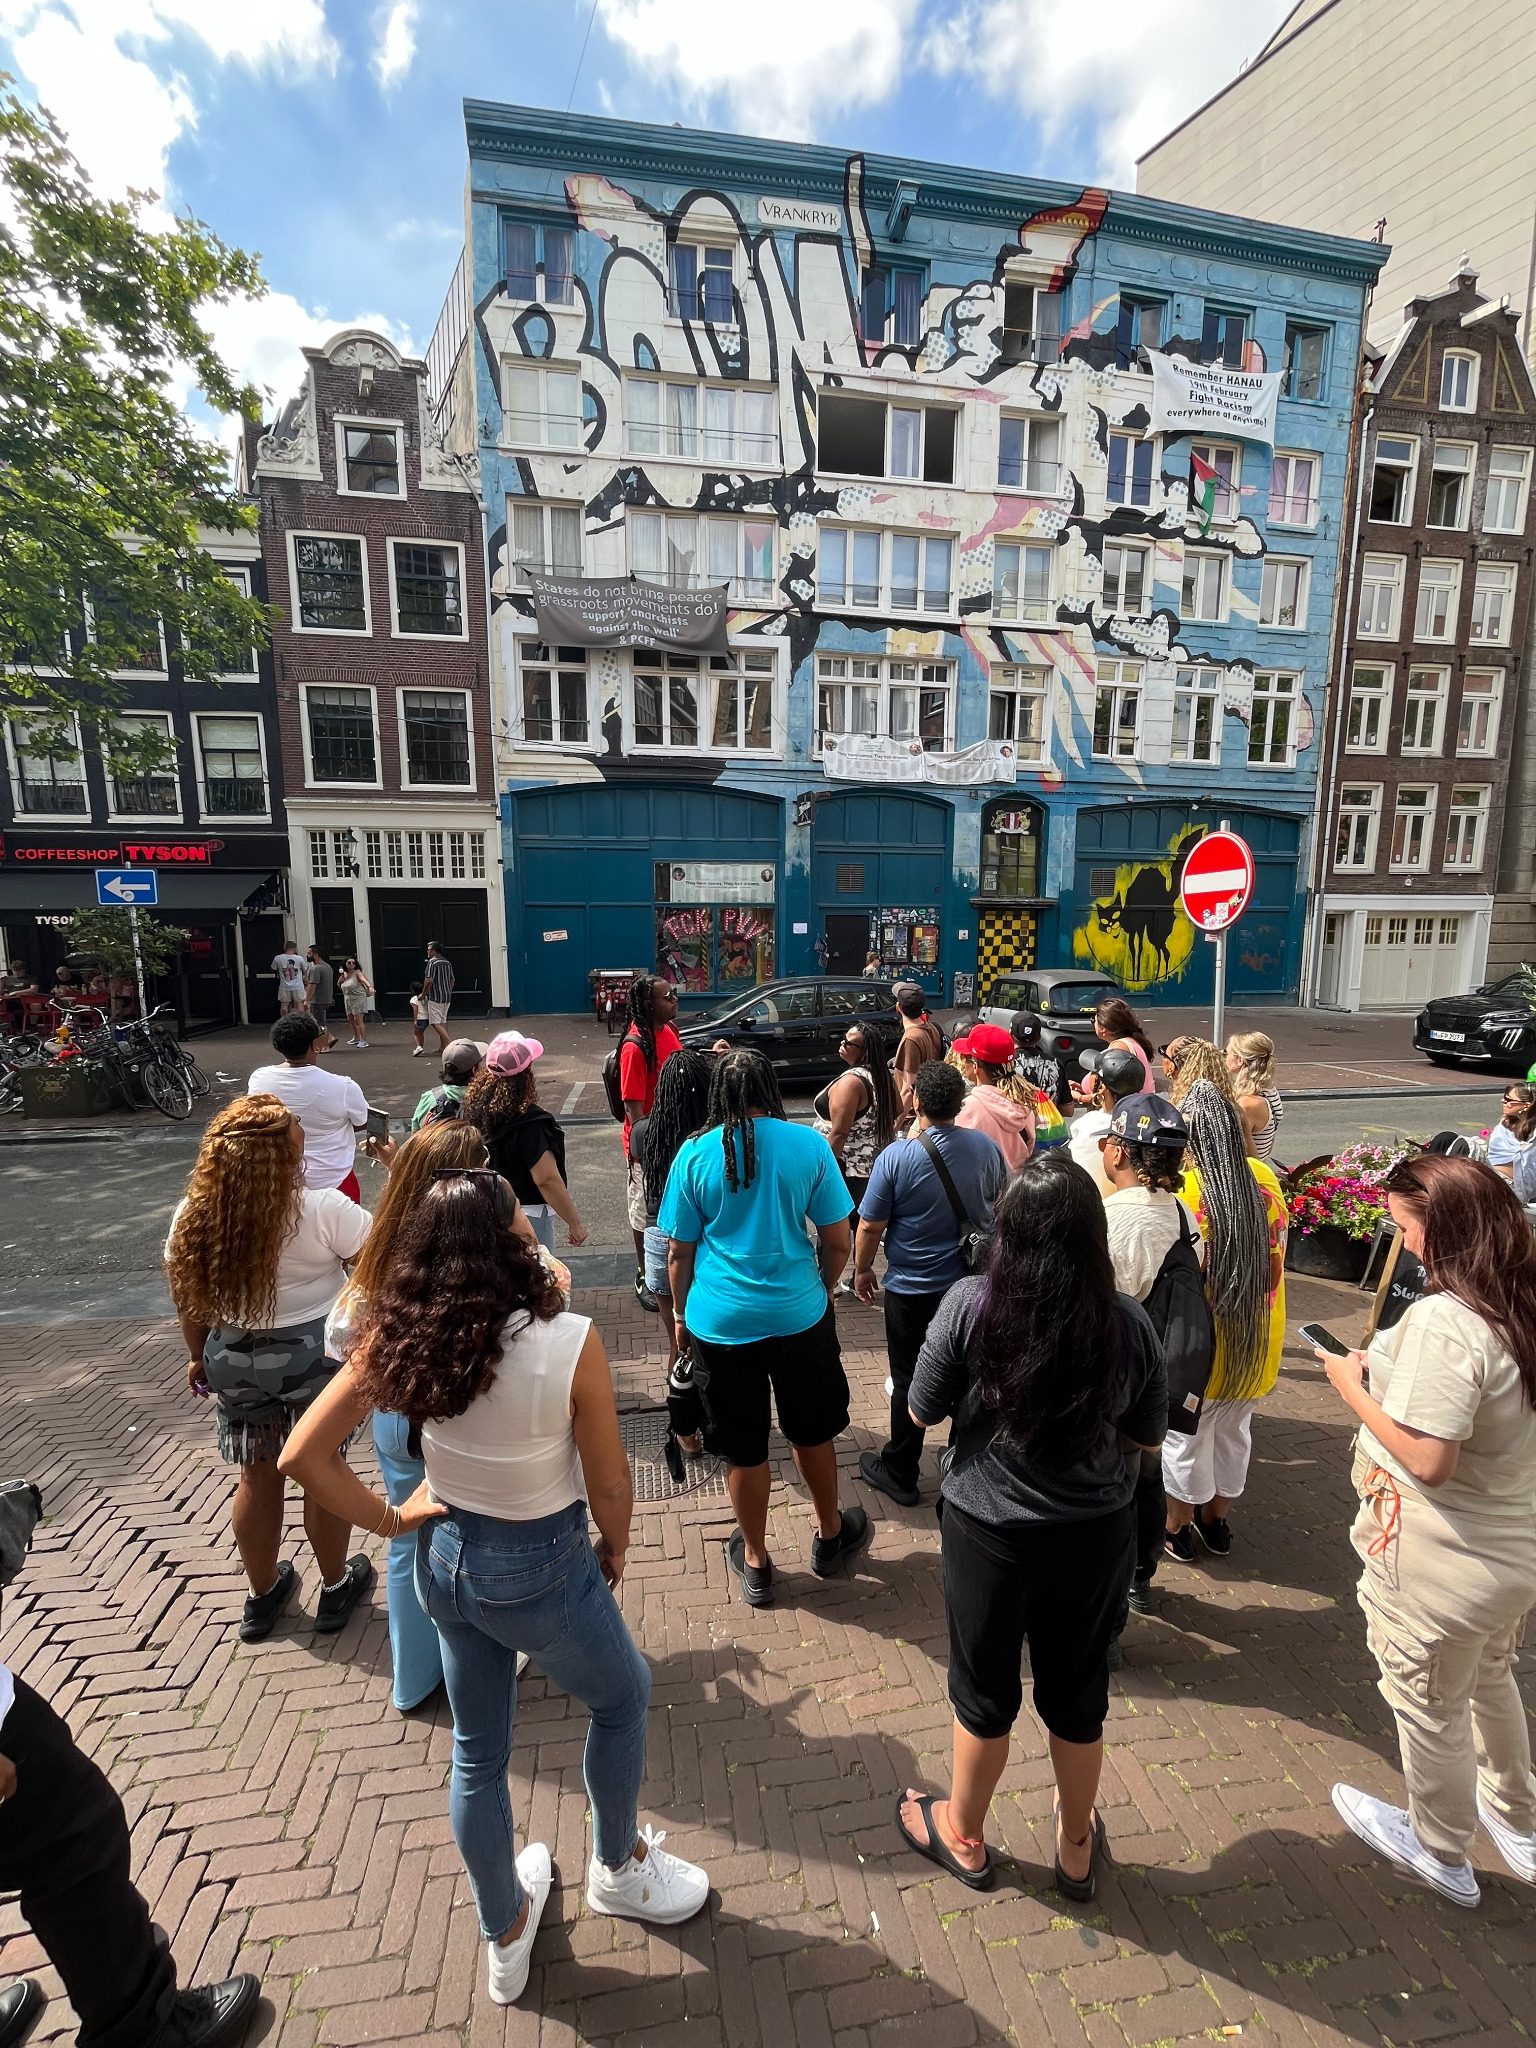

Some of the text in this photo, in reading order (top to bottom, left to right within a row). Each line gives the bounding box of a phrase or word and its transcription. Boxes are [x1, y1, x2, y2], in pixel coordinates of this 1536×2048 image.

[762, 201, 838, 226] VRANKRYK
[1172, 363, 1263, 388] Remember HANAU
[1189, 380, 1248, 400] 19th February
[1189, 390, 1252, 415] Fight Racism
[1166, 407, 1220, 418] everywhere
[1232, 414, 1267, 427] anytime!
[535, 579, 579, 596] States
[583, 586, 600, 597] do
[604, 585, 626, 598] not
[630, 583, 664, 602] bring
[669, 590, 712, 604] peace
[539, 594, 719, 616] grassroots movements do!
[582, 606, 689, 626] support 'anarchists
[588, 621, 680, 638] against the wall'
[619, 634, 656, 646] & PCFF
[14, 846, 206, 861] COFFEESHOP TYSON
[663, 909, 707, 940] FCK
[1392, 1282, 1425, 1301] Swe
